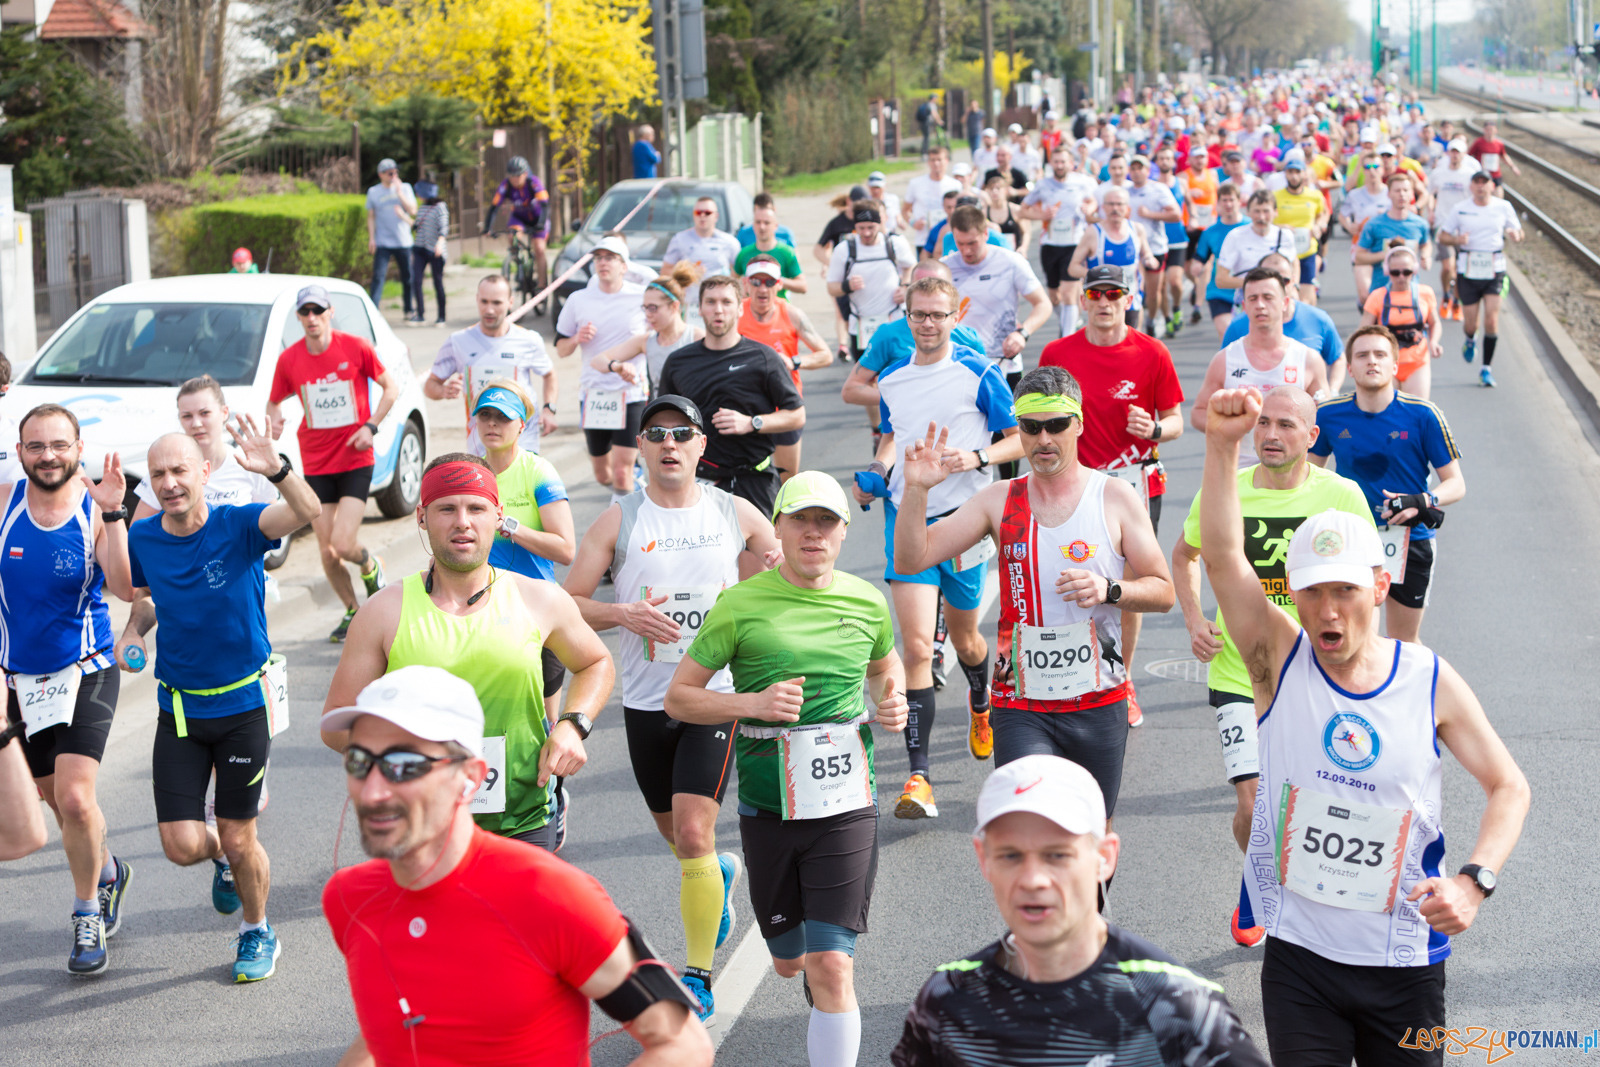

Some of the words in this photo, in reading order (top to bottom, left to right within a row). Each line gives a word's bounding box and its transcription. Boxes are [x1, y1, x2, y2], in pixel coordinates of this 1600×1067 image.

[1231, 368, 1248, 378] 4F
[315, 396, 347, 409] 4663
[590, 401, 618, 412] 7448
[658, 537, 697, 548] ROYAL
[1013, 562, 1028, 627] POLON
[1025, 645, 1092, 669] 10290
[1041, 670, 1078, 678] Przemysław
[25, 683, 69, 706] 2294
[278, 685, 288, 703] 2
[1220, 725, 1245, 749] 32
[811, 753, 852, 780] 853
[820, 781, 847, 791] Grzegorz
[1316, 770, 1376, 792] 12.09.2010
[472, 797, 488, 805] miej
[1302, 826, 1385, 867] 5023
[685, 870, 708, 878] ROYAL
[1318, 863, 1360, 879] Krzysztof
